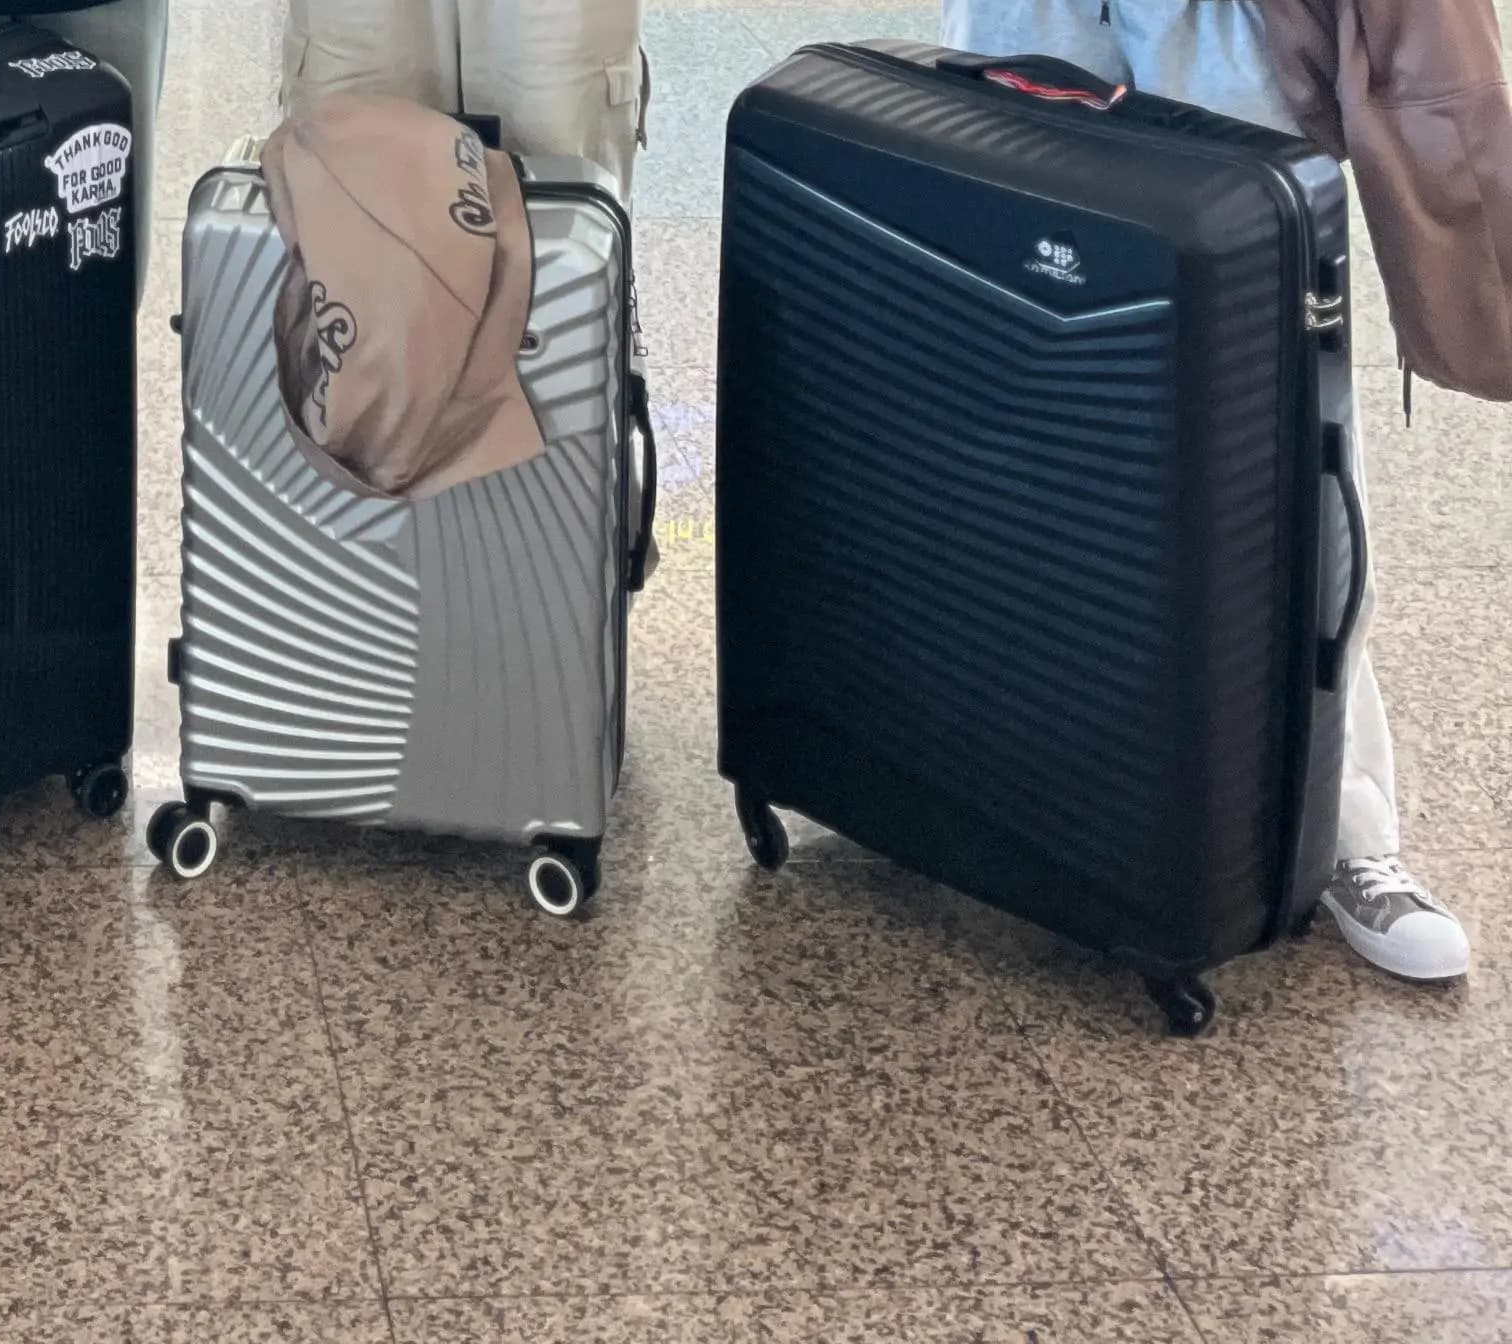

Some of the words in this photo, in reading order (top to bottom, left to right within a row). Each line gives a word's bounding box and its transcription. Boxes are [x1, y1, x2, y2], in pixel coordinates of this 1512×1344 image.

[54, 130, 102, 171] THANK
[103, 130, 129, 153] GOD
[63, 169, 86, 191] FOR
[91, 157, 122, 181] GOOD
